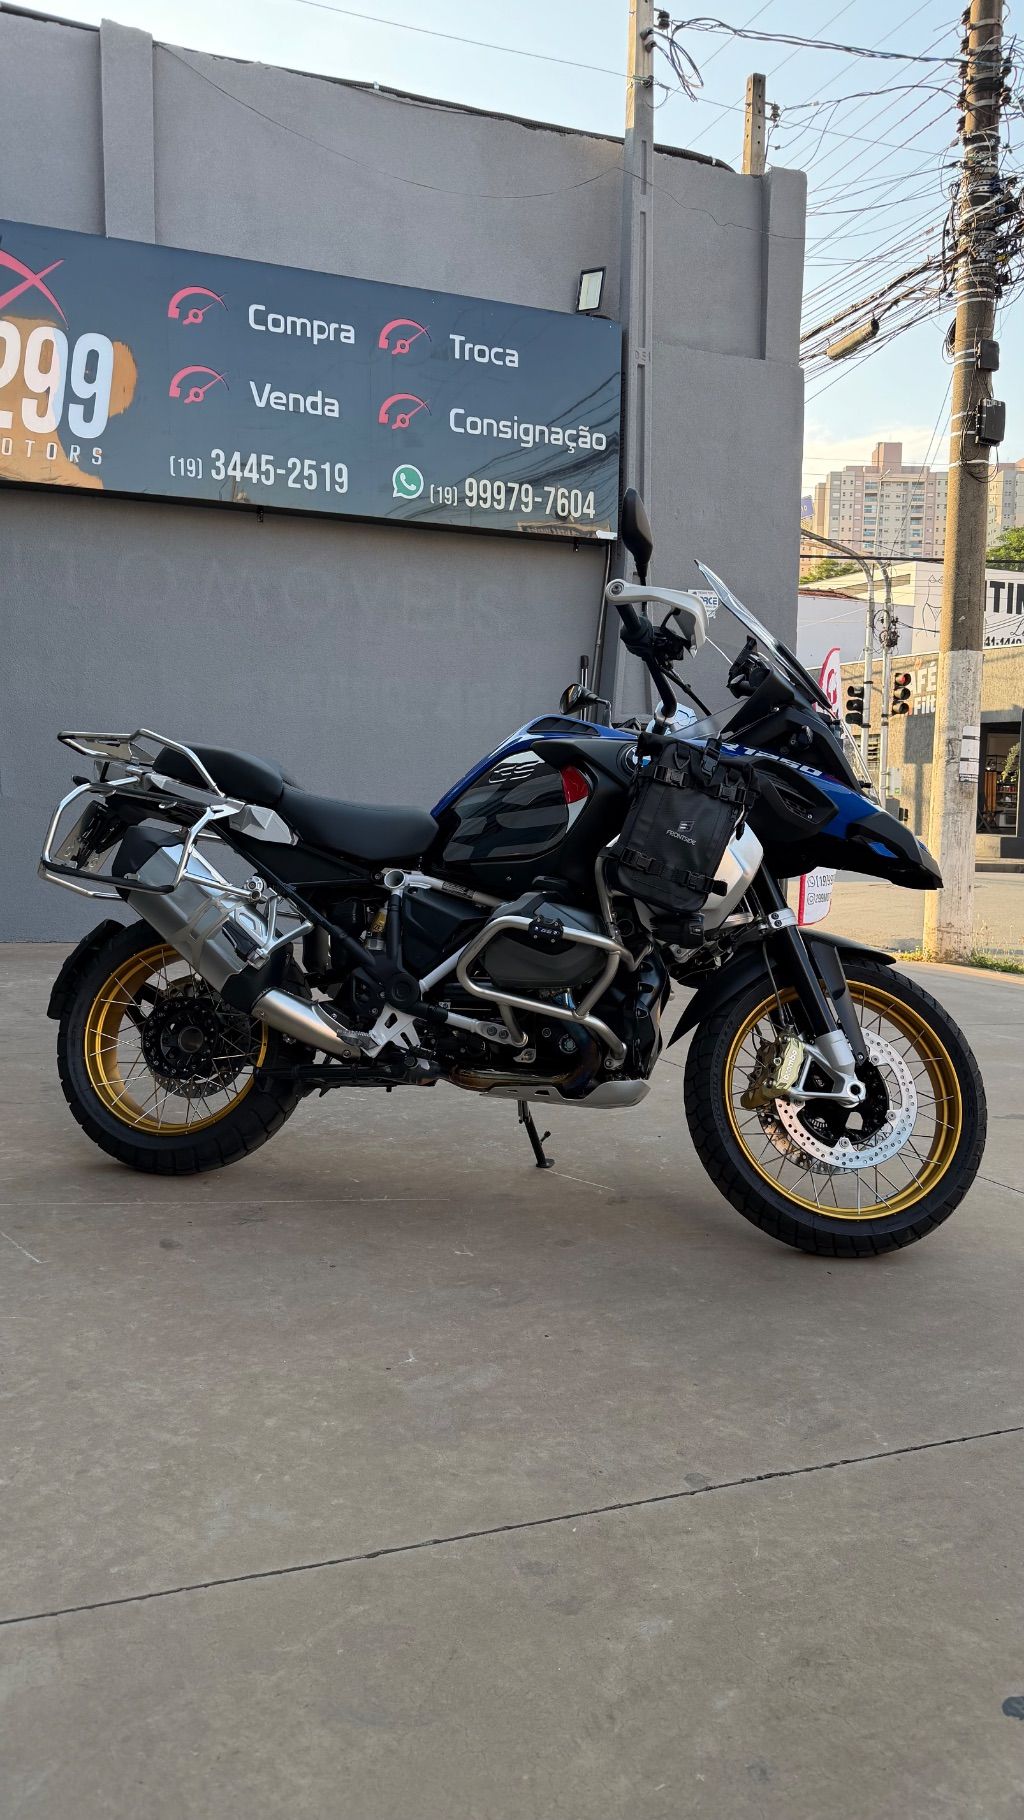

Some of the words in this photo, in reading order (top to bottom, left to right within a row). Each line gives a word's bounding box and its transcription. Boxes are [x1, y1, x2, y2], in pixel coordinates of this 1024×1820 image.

[248, 304, 356, 345] Compra
[449, 334, 519, 368] Troca
[249, 381, 340, 418] Venda
[449, 409, 607, 454] Consignação
[1, 437, 103, 465] OTORS
[169, 455, 203, 479] (19)
[210, 449, 349, 494] 3445-2519
[430, 485, 458, 506] (19)
[464, 477, 596, 519] 99979-7604
[700, 596, 717, 605] RCE
[906, 661, 937, 695] AFÉ
[914, 695, 936, 715] Filt
[783, 1050, 798, 1081] brembo
